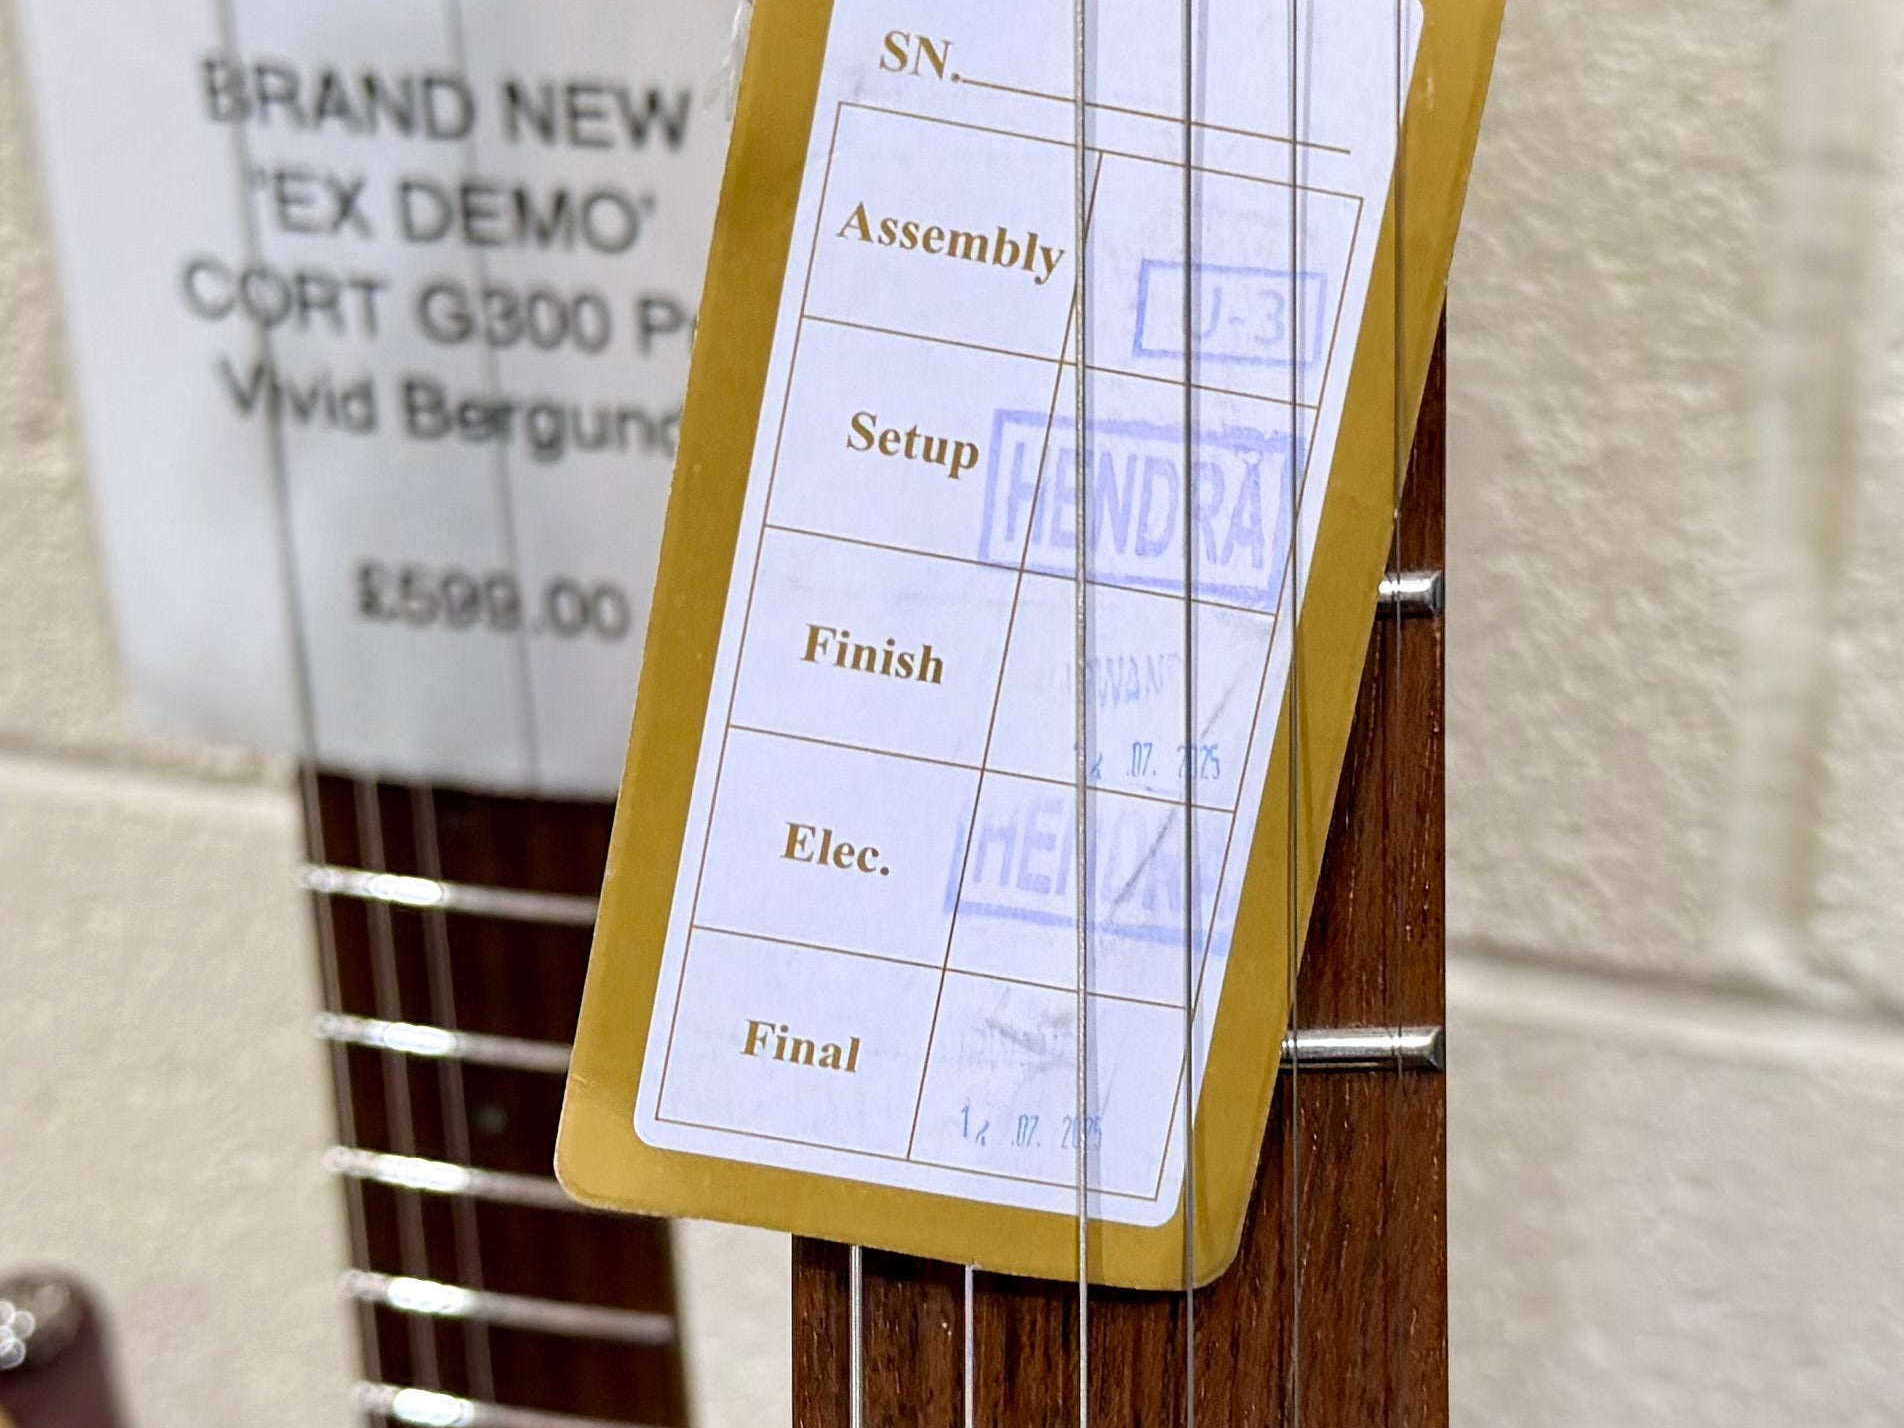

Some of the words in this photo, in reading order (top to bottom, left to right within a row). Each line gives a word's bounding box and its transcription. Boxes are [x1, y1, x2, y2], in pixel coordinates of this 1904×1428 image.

[878, 30, 964, 84] SN.
[201, 57, 477, 141] BRAND
[504, 78, 693, 152] NEW
[836, 202, 1067, 285] Assembly
[182, 259, 390, 336] CORT
[418, 279, 612, 353] G300
[637, 296, 698, 356] P
[218, 356, 378, 434] Vivid
[846, 410, 981, 480] Setup
[1005, 441, 1266, 570] HENDRA
[799, 622, 946, 685] Finish
[780, 820, 892, 876] Elec.
[740, 1018, 861, 1074] Final
